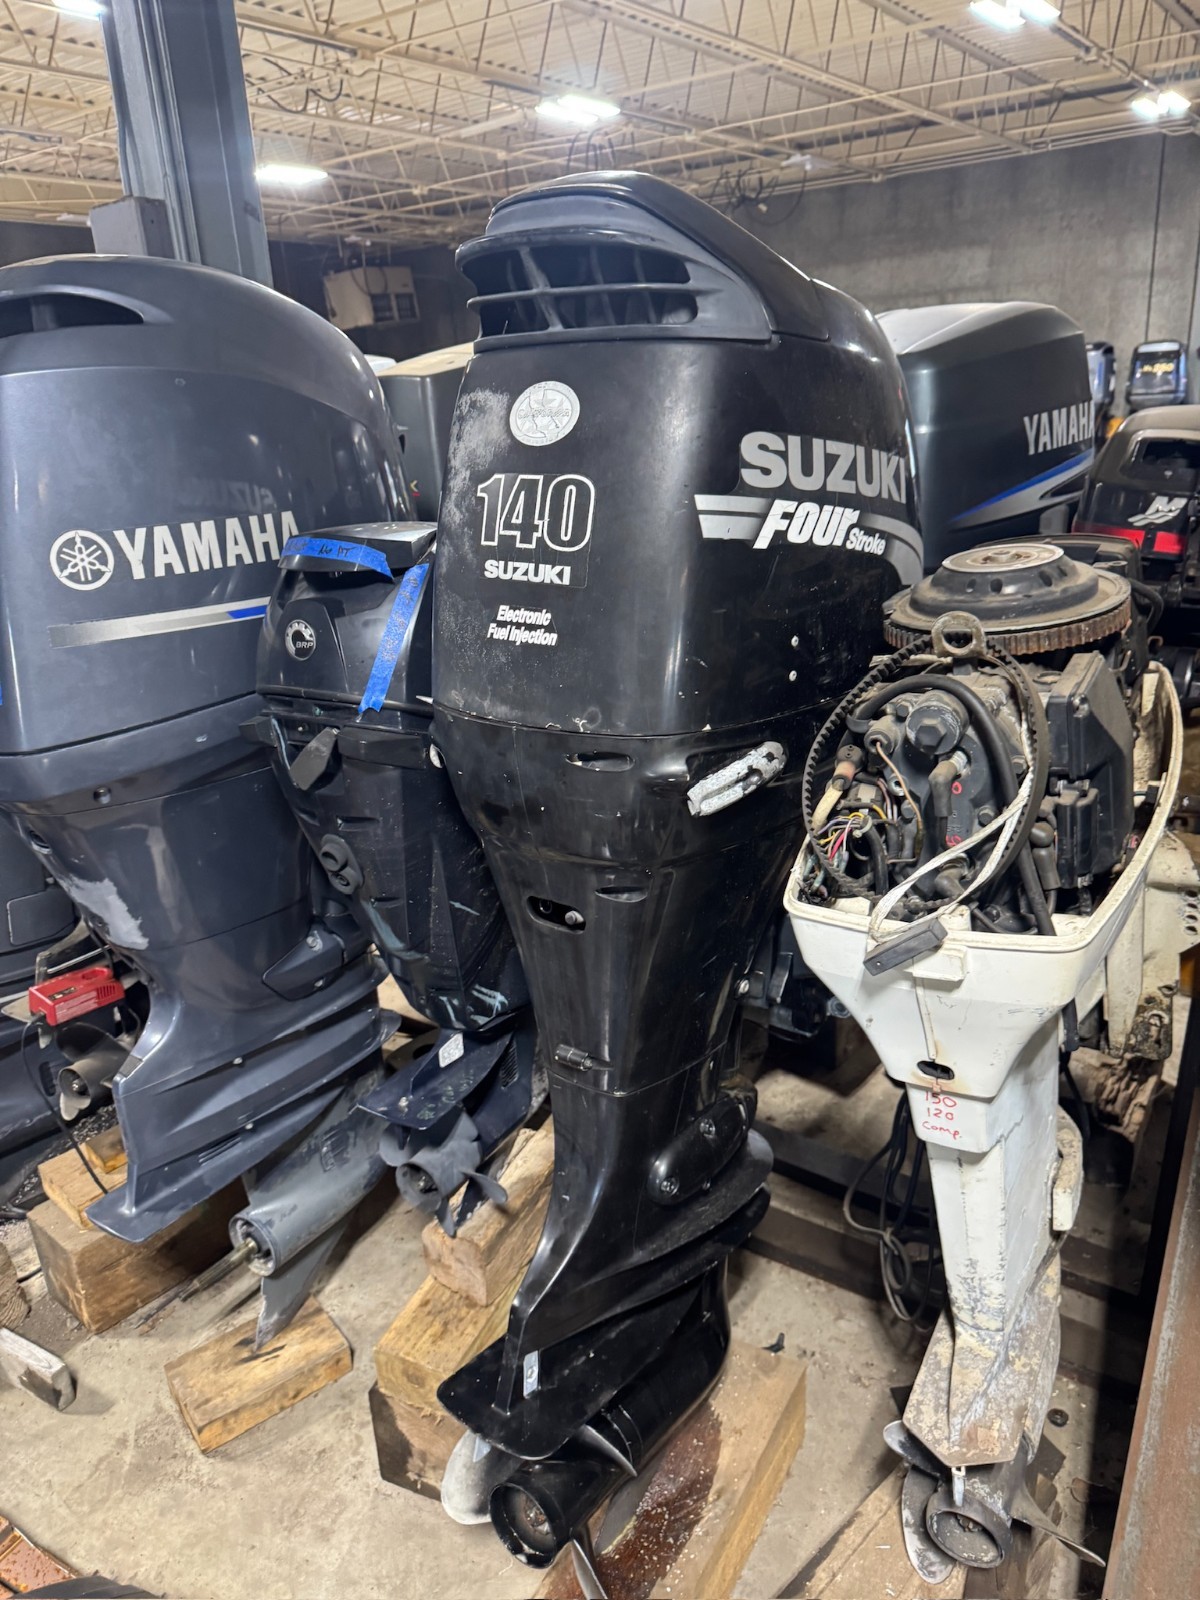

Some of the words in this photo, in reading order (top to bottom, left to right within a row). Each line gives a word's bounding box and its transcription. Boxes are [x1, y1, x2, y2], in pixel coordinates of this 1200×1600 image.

[740, 431, 906, 504] SUZUKI
[477, 474, 595, 552] 140
[846, 526, 886, 556] Stroke
[484, 559, 571, 585] SUZUKI
[496, 604, 552, 626] Electronic
[295, 641, 314, 649] BRP
[487, 623, 509, 641] Fuel
[509, 624, 558, 646] Injection
[925, 1090, 957, 1108] 150
[927, 1107, 954, 1121] 120
